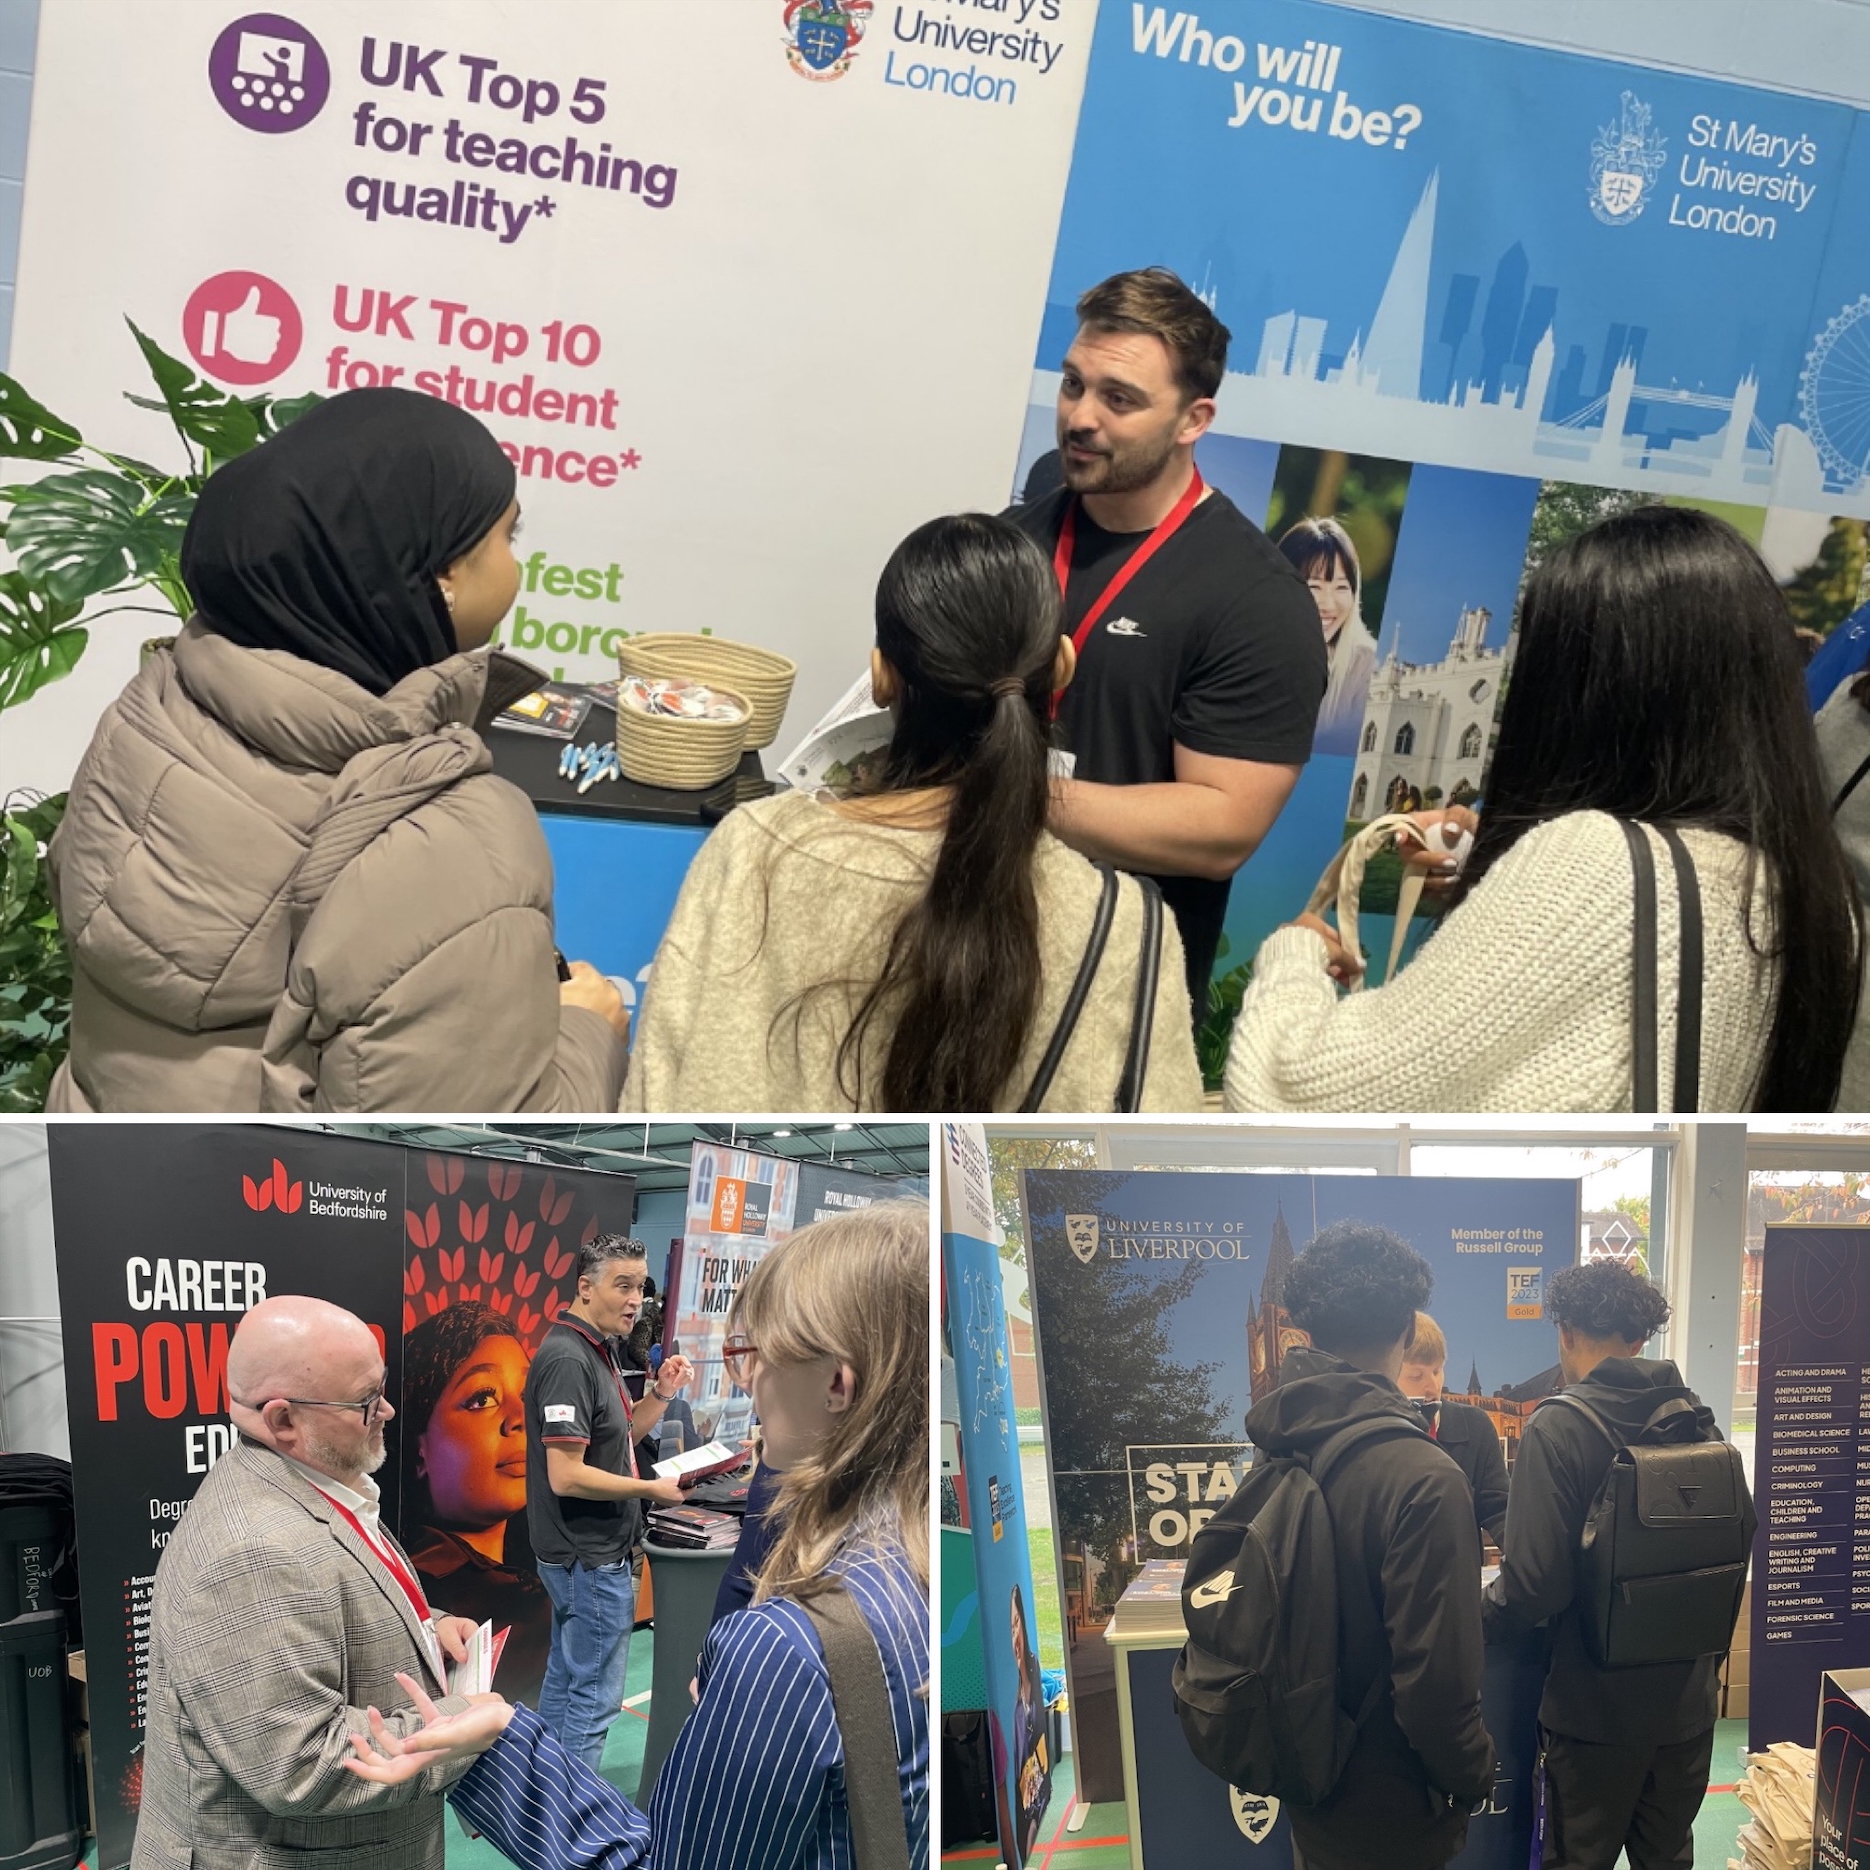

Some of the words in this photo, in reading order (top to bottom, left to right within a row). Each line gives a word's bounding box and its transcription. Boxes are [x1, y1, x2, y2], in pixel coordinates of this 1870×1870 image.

[894, 6, 1063, 73] University
[1131, 3, 1245, 73] Who
[1258, 40, 1342, 92] will
[359, 36, 448, 98] UK
[458, 54, 560, 124] Top
[568, 77, 607, 125] 5
[885, 51, 1016, 104] London
[1227, 82, 1321, 132] you
[1329, 91, 1422, 149] be?
[1687, 115, 1721, 148] St
[1726, 120, 1817, 167] Mary's
[352, 102, 432, 157] for
[443, 117, 679, 209] teaching
[1679, 155, 1816, 211] University
[1669, 194, 1777, 240] London
[332, 283, 418, 340] UK
[429, 300, 530, 364] Top
[540, 320, 602, 368] 10
[326, 346, 403, 389] for
[415, 365, 619, 430] student
[516, 551, 624, 603] fest
[309, 1181, 371, 1204] University
[374, 1189, 387, 1203] of
[309, 1199, 387, 1220] Bedfordshire
[1106, 1221, 1214, 1233] UNIVERSITY
[1223, 1222, 1244, 1233] OF
[1451, 1228, 1505, 1240] Member
[1507, 1228, 1521, 1239] of
[1523, 1228, 1543, 1239] the
[1108, 1238, 1250, 1260] LIVERPOOL
[1456, 1242, 1501, 1253] Russell
[1504, 1242, 1543, 1256] Group
[702, 1257, 729, 1283] FOR
[126, 1256, 267, 1311] CAREER
[1510, 1275, 1540, 1287] TEF
[1511, 1289, 1539, 1299] 2023
[1514, 1307, 1535, 1316] Gold
[1775, 1369, 1803, 1377] ACTING
[1821, 1368, 1846, 1376] DRAMA
[1774, 1386, 1816, 1395] ANIMATION
[1774, 1396, 1801, 1404] VISUAL
[1773, 1413, 1788, 1421] ART
[1805, 1412, 1832, 1420] DESIGN
[1772, 1430, 1818, 1439] BIOMEDICAL
[1819, 1429, 1851, 1437] SCIENCE
[185, 1424, 239, 1474] ED
[1772, 1447, 1809, 1456] BUSINESS
[1809, 1446, 1840, 1454] SCHOOL
[1771, 1464, 1817, 1473] COMPUTING
[1146, 1461, 1252, 1503] STA
[1771, 1481, 1823, 1490] CRIMINOLOGY
[1770, 1498, 1815, 1507] EDUCATION,
[1770, 1507, 1806, 1516] CHILDREN
[1807, 1506, 1823, 1514] AND
[1769, 1516, 1807, 1524] TEACHING
[1769, 1532, 1818, 1541] ENGINEERING
[1768, 1549, 1801, 1558] ENGLISH,
[1802, 1547, 1837, 1556] CREATIVE
[1768, 1558, 1800, 1566] WRITING
[1768, 1565, 1814, 1574] JOURNALISM
[1767, 1582, 1801, 1591] ESPORTS
[1767, 1599, 1784, 1607] FILM
[1785, 1598, 1801, 1606] AND
[1801, 1597, 1824, 1605] MEDIA
[1767, 1614, 1803, 1623] FORENSIC
[1803, 1613, 1835, 1621] SCIENCE
[1766, 1631, 1792, 1640] GAMES
[28, 1664, 52, 1678] UOB
[1822, 1814, 1842, 1841] Your
[1820, 1834, 1845, 1863] place
[1846, 1857, 1859, 1870] of
